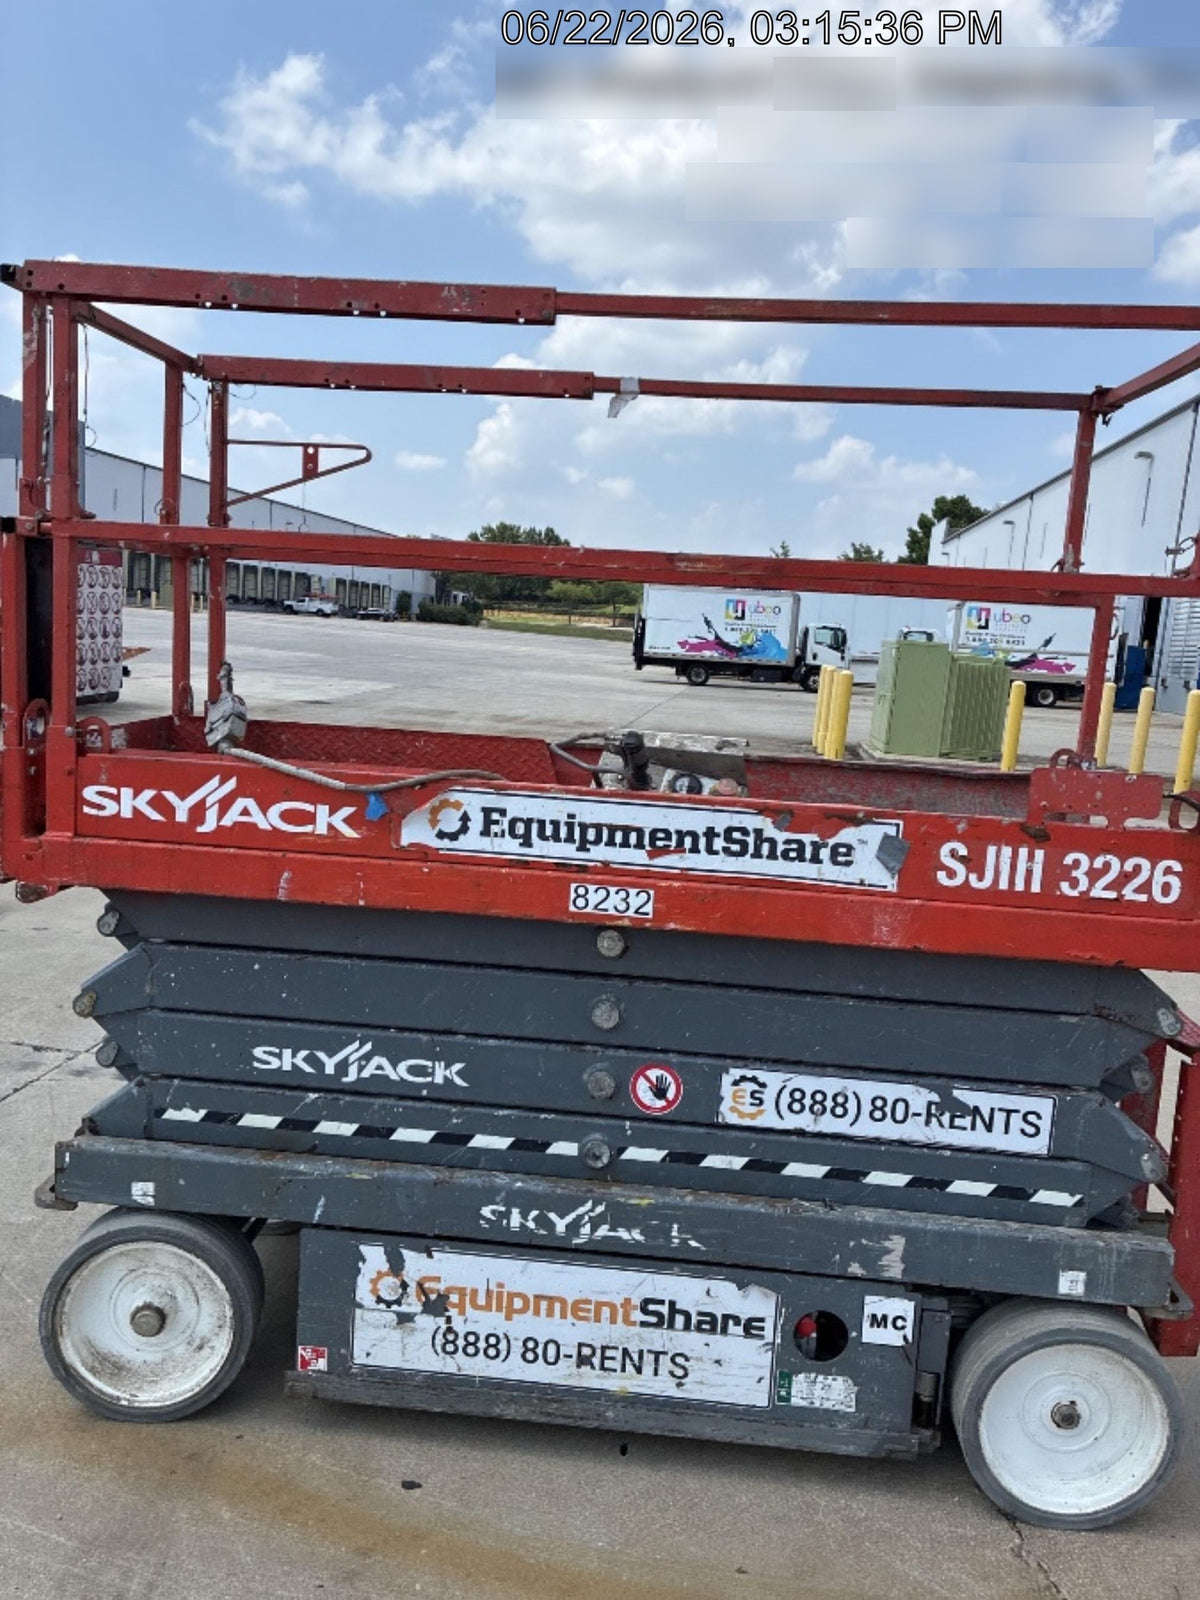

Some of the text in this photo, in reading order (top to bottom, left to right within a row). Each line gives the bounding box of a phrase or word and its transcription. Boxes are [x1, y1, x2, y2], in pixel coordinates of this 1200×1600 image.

[81, 773, 362, 839] SKYJACK
[479, 806, 857, 868] EquipmentShare
[571, 884, 655, 918] 8232
[1058, 852, 1183, 904] 3226
[251, 1039, 470, 1088] SKYJACK
[774, 1084, 863, 1127] (888)
[415, 1275, 766, 1340] EquipmentShare
[869, 1313, 907, 1330] MC
[431, 1324, 691, 1380] (888) 80-RENTS
